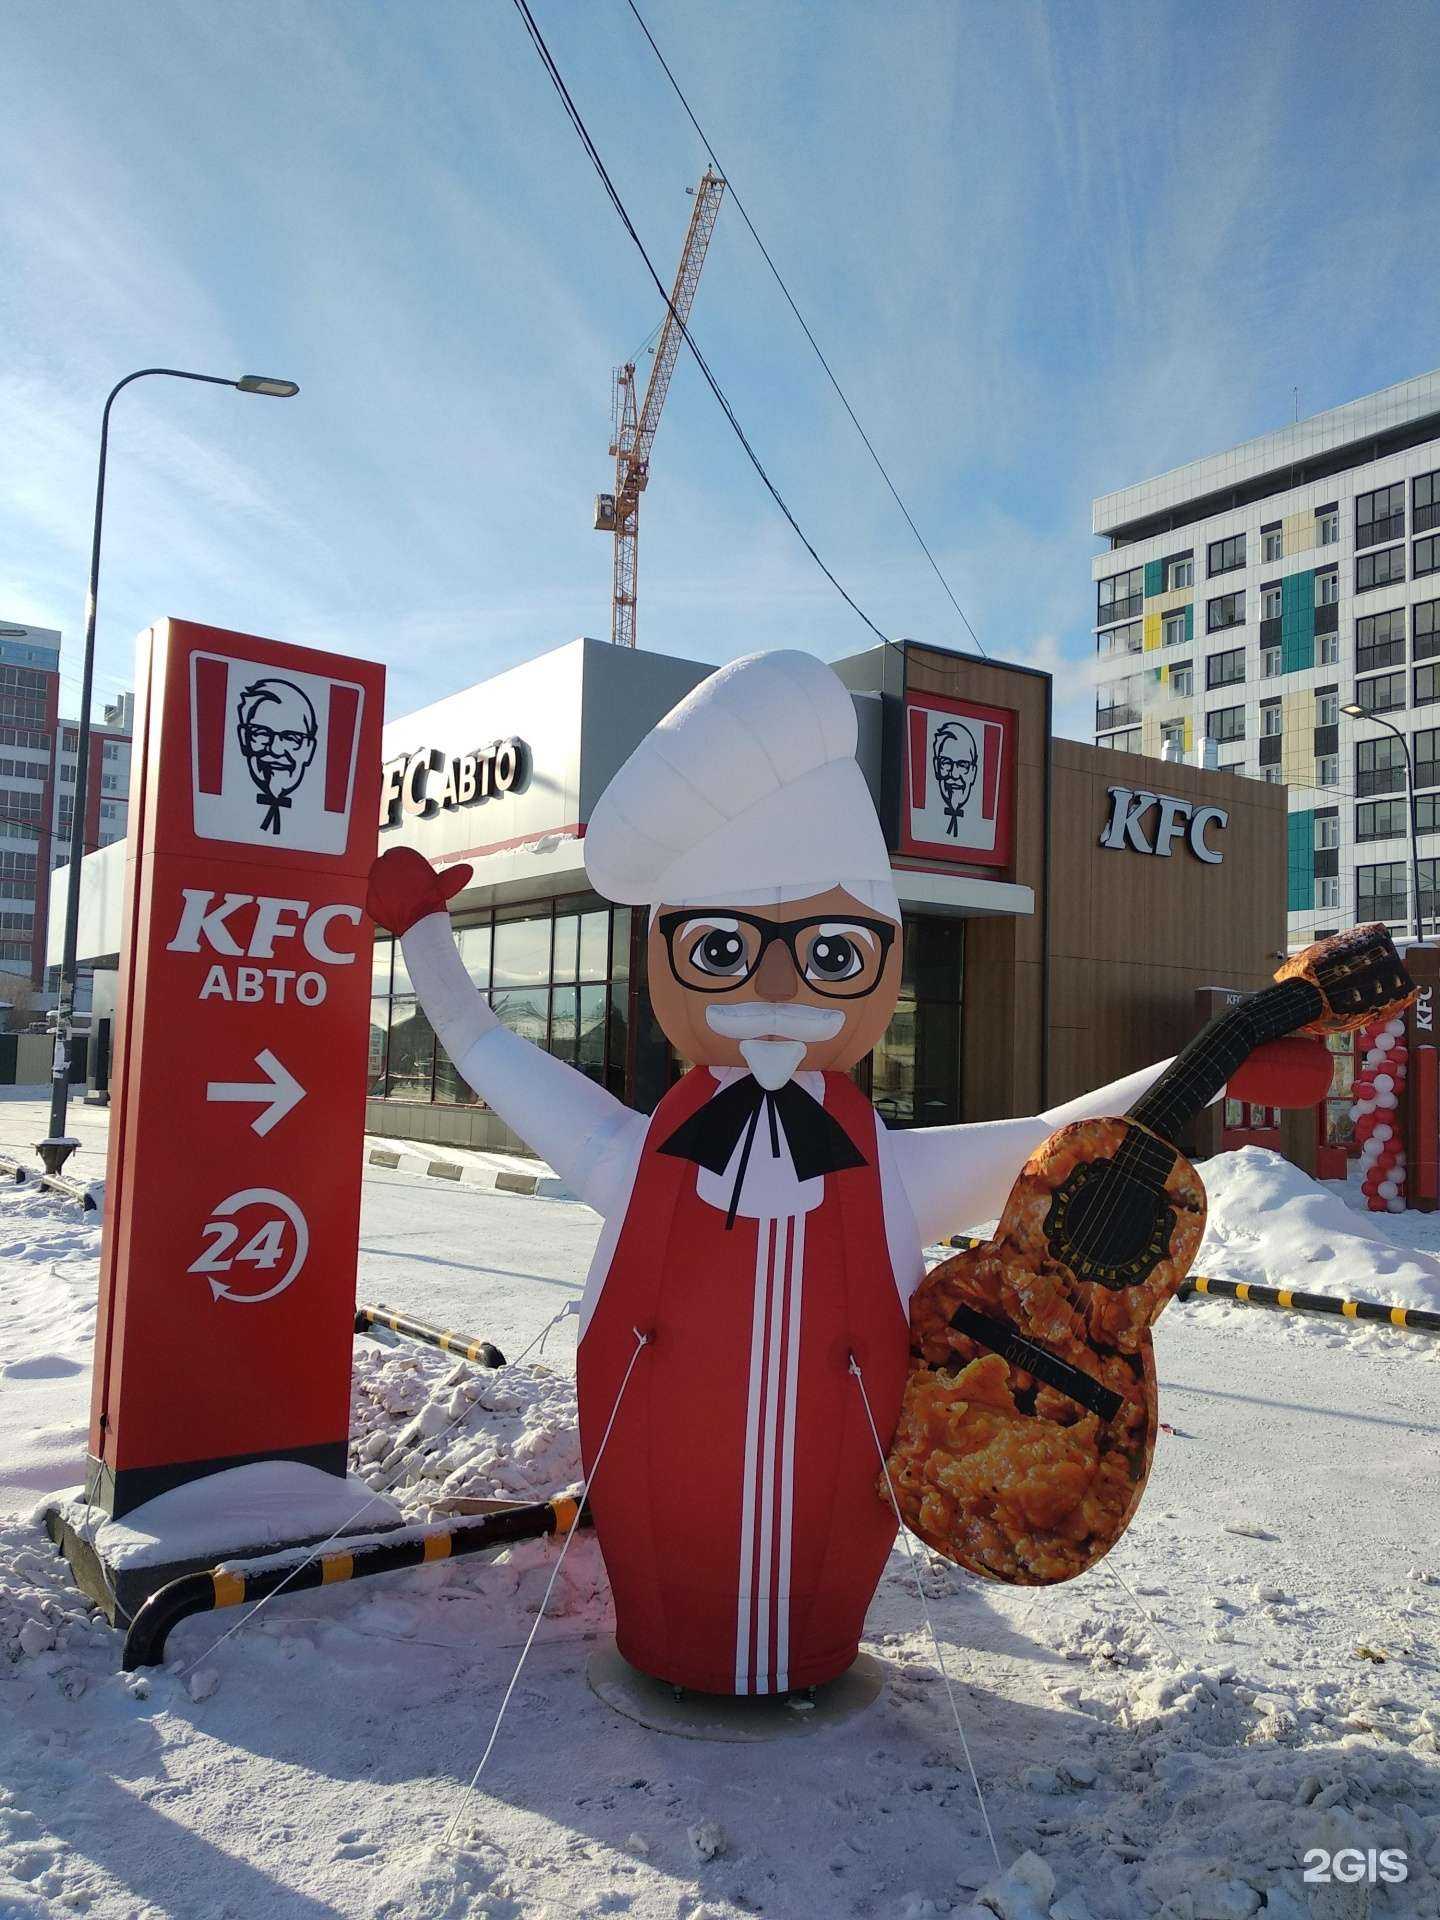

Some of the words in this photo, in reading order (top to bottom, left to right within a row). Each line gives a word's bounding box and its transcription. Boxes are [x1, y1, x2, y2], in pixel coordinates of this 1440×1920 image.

[379, 747, 434, 828] FC
[438, 741, 521, 808] АВТО
[1101, 786, 1229, 864] KFC
[166, 888, 363, 965] KFC
[198, 965, 327, 1007] АВТО
[1416, 985, 1433, 1032] KFC
[186, 1220, 287, 1273] 24
